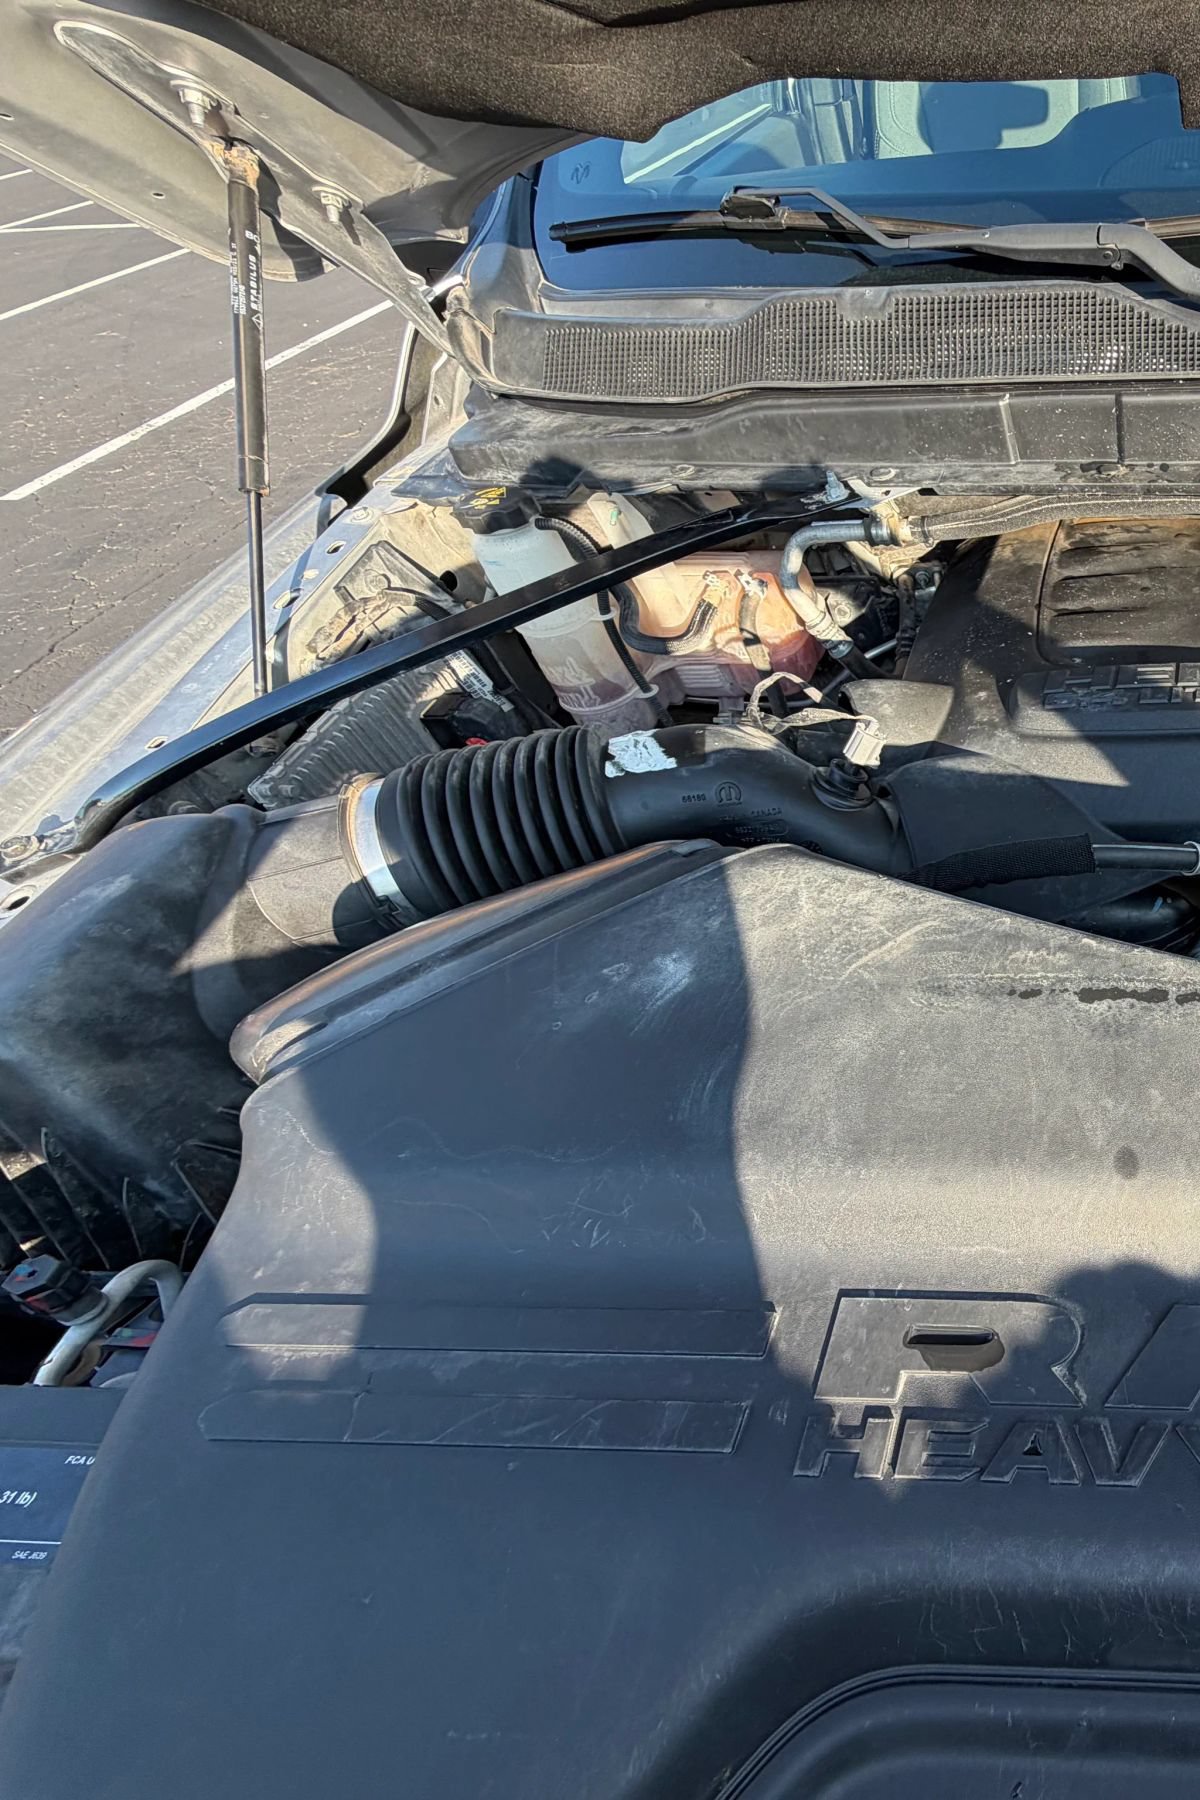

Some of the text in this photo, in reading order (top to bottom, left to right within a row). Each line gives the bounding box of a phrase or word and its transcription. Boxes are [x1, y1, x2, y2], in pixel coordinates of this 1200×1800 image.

[248, 254, 259, 311] STABILUS
[64, 1455, 86, 1465] FCA
[15, 1491, 38, 1508] lb)
[11, 1550, 31, 1560] SAE
